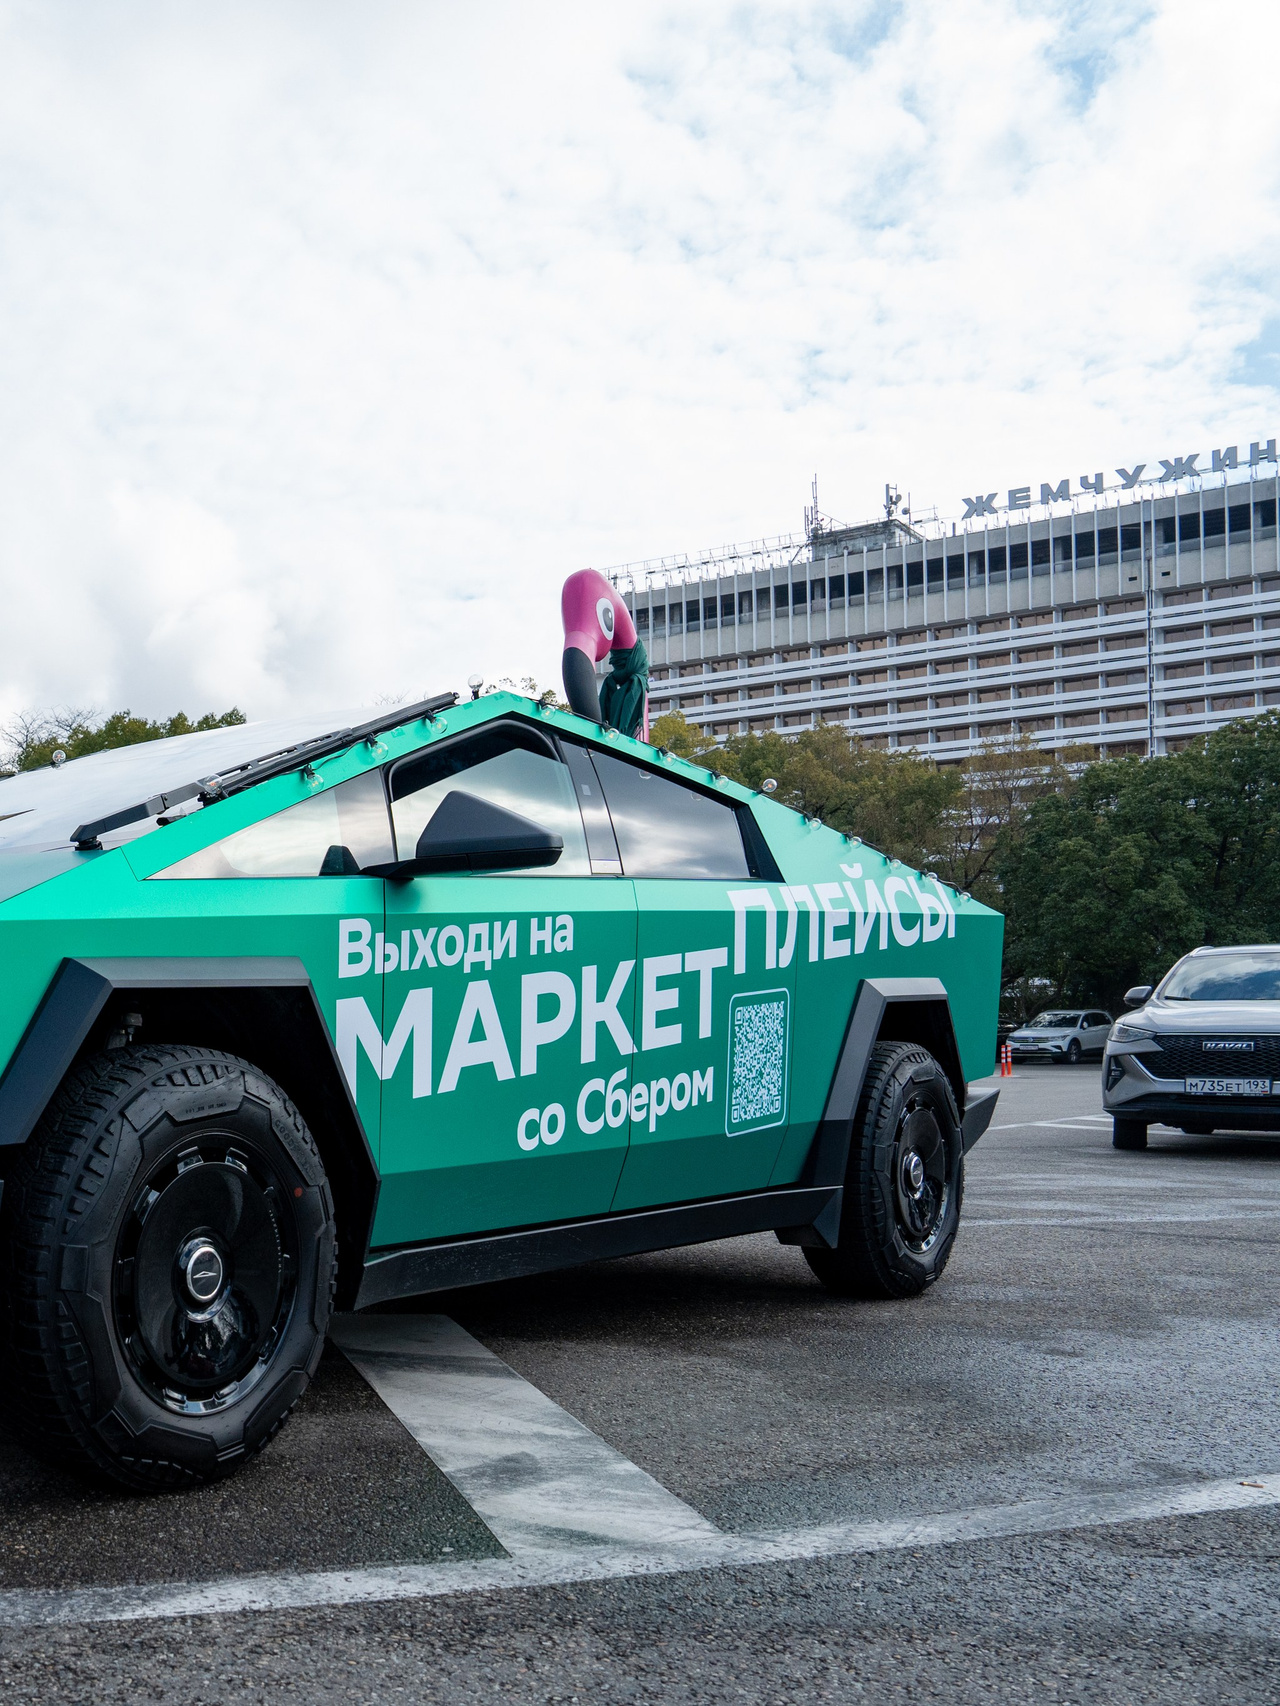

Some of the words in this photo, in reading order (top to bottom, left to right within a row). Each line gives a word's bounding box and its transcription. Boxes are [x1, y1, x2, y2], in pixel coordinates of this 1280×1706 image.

[961, 438, 1276, 520] ЖЕМЧУЖИН
[338, 917, 518, 979] Выходи
[529, 914, 574, 956] на
[516, 1102, 566, 1151] со
[576, 1066, 714, 1136] Сбером
[1189, 1080, 1242, 1092] М735ЕТ
[1245, 1080, 1266, 1090] 193
